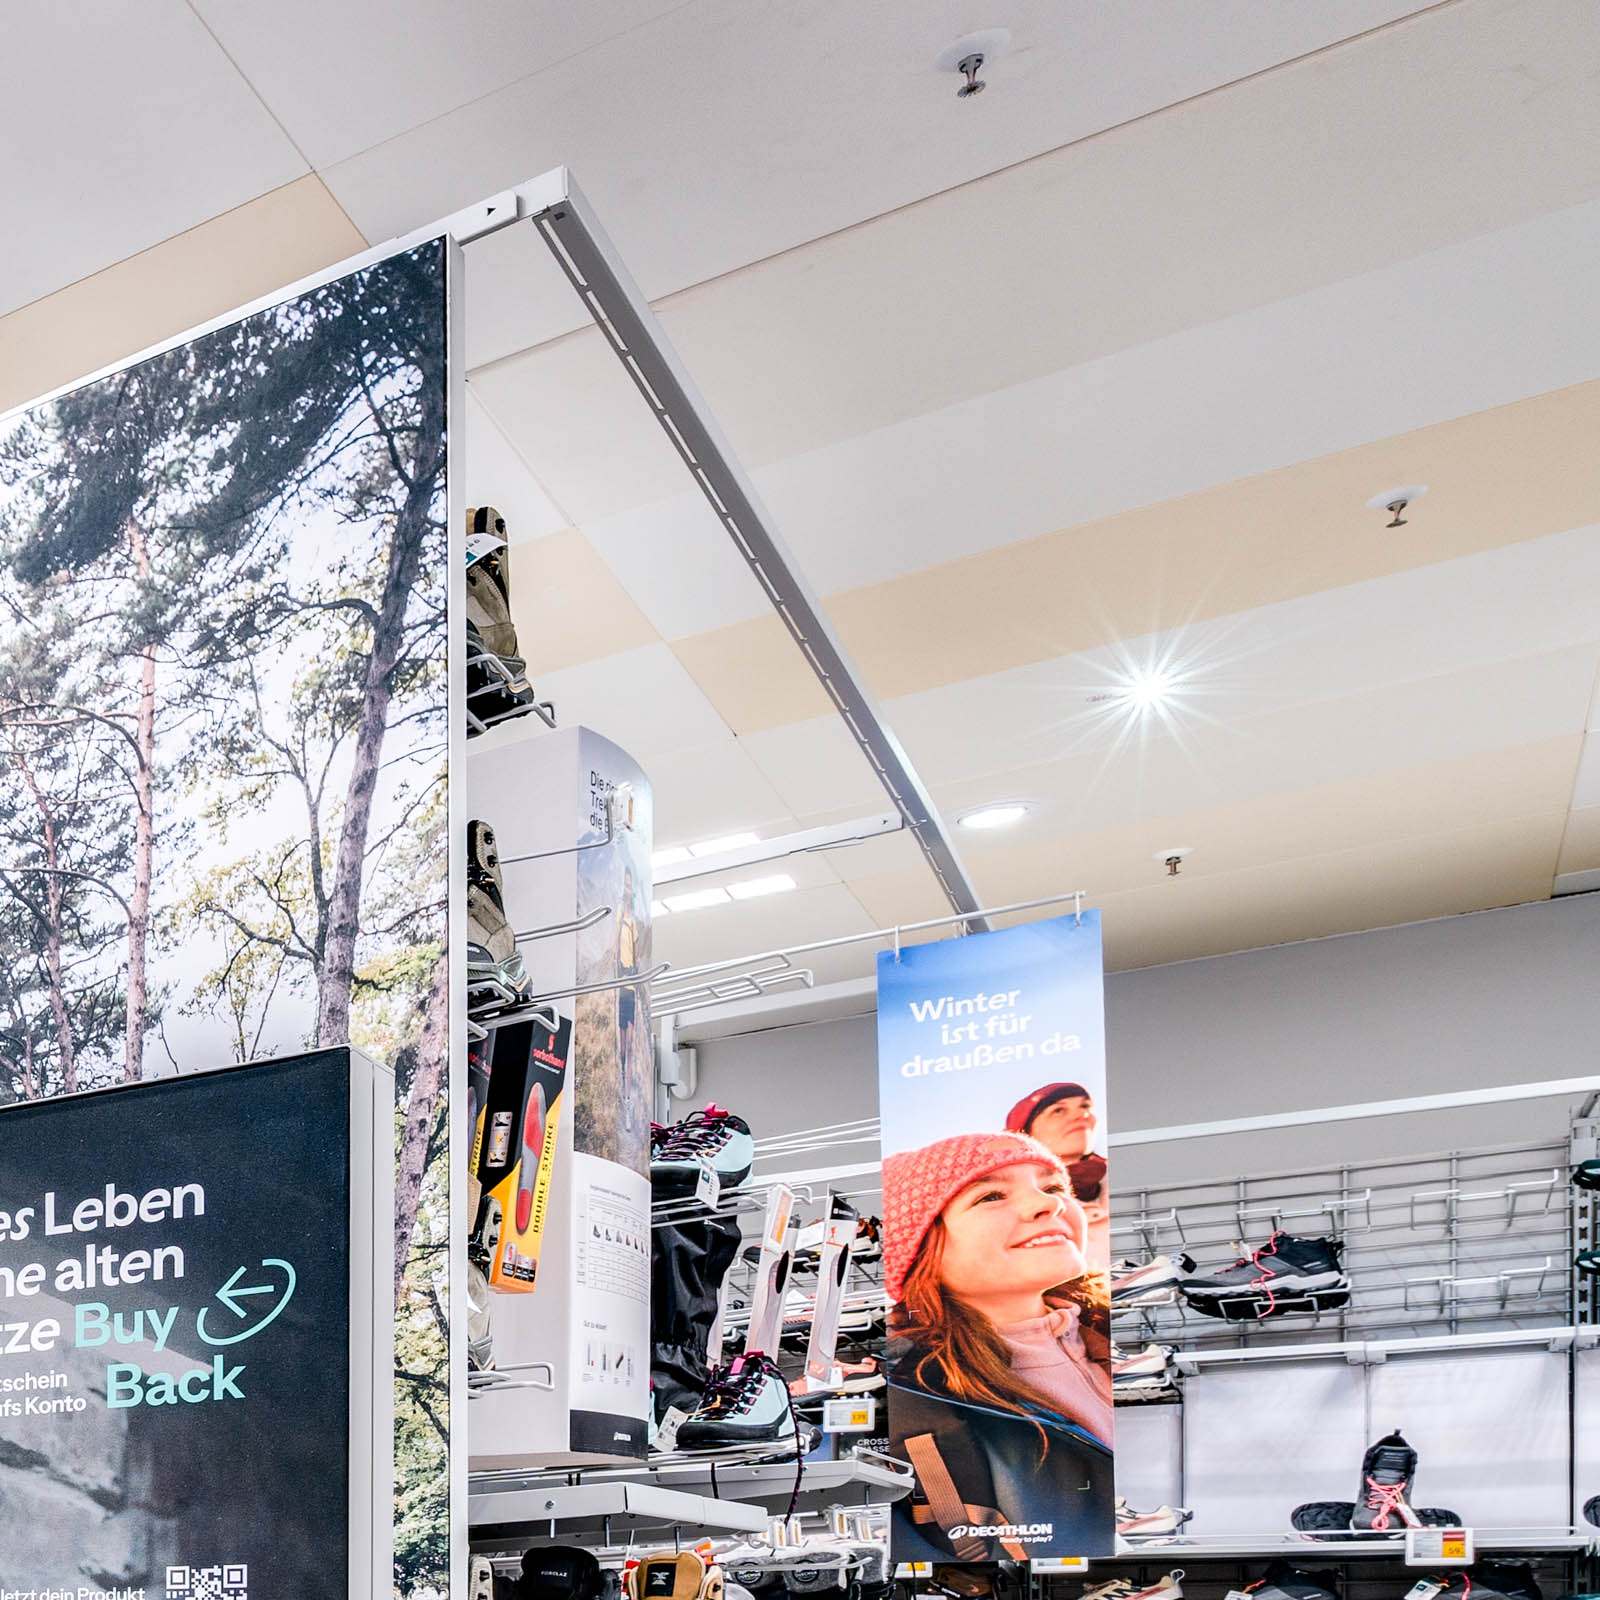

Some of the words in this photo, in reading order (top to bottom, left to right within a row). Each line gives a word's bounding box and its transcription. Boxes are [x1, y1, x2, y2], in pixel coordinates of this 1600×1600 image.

[909, 988, 1021, 1023] Winter
[941, 1020, 981, 1046] ist
[984, 1012, 1033, 1038] für
[901, 1042, 1035, 1078] draußen
[1039, 1031, 1082, 1055] da
[43, 1181, 206, 1237] Leben
[53, 1243, 185, 1292] alten
[74, 1300, 180, 1352] Buy
[106, 1354, 247, 1409] Back
[25, 1395, 88, 1416] Konto
[967, 1523, 1053, 1537] DECATHLON
